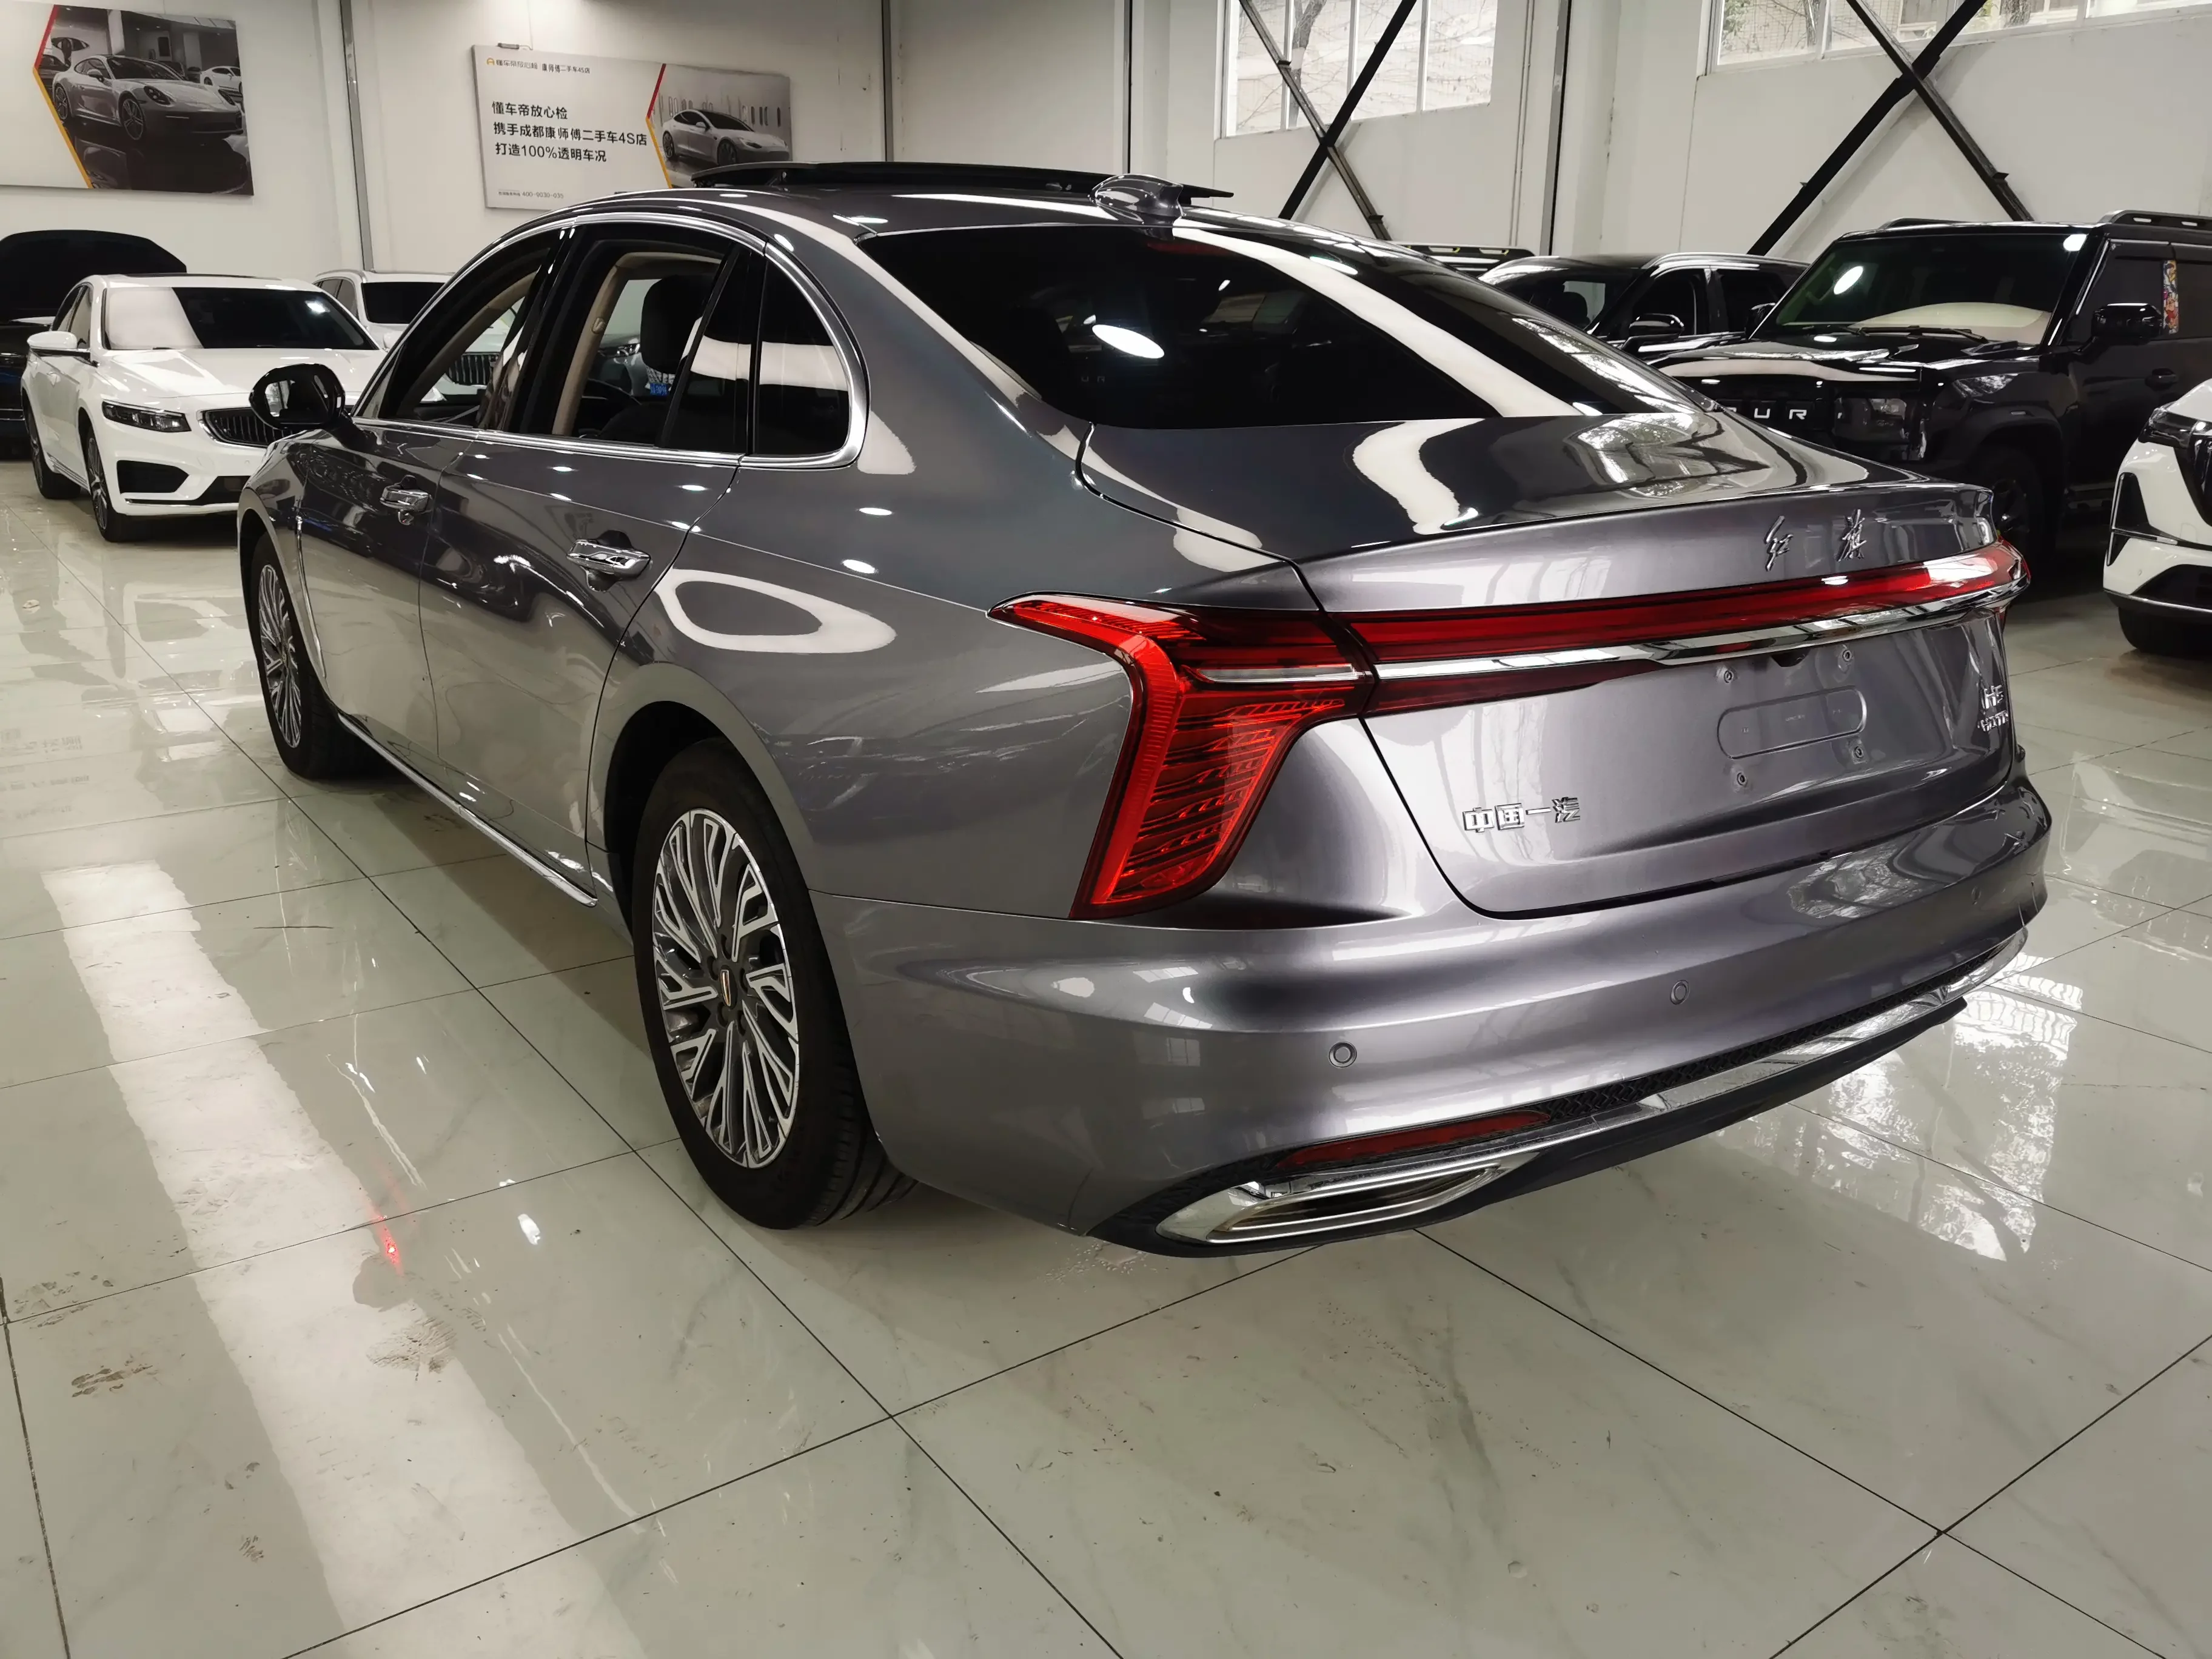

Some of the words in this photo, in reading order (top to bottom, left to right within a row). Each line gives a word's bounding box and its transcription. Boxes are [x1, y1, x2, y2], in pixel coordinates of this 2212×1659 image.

[492, 101, 568, 119] 懂车帝放心检
[493, 121, 648, 146] 携手成都康师傅二手车4S店
[495, 142, 607, 163] 打造100%透明车况
[1462, 797, 1581, 833] 中国一汽
